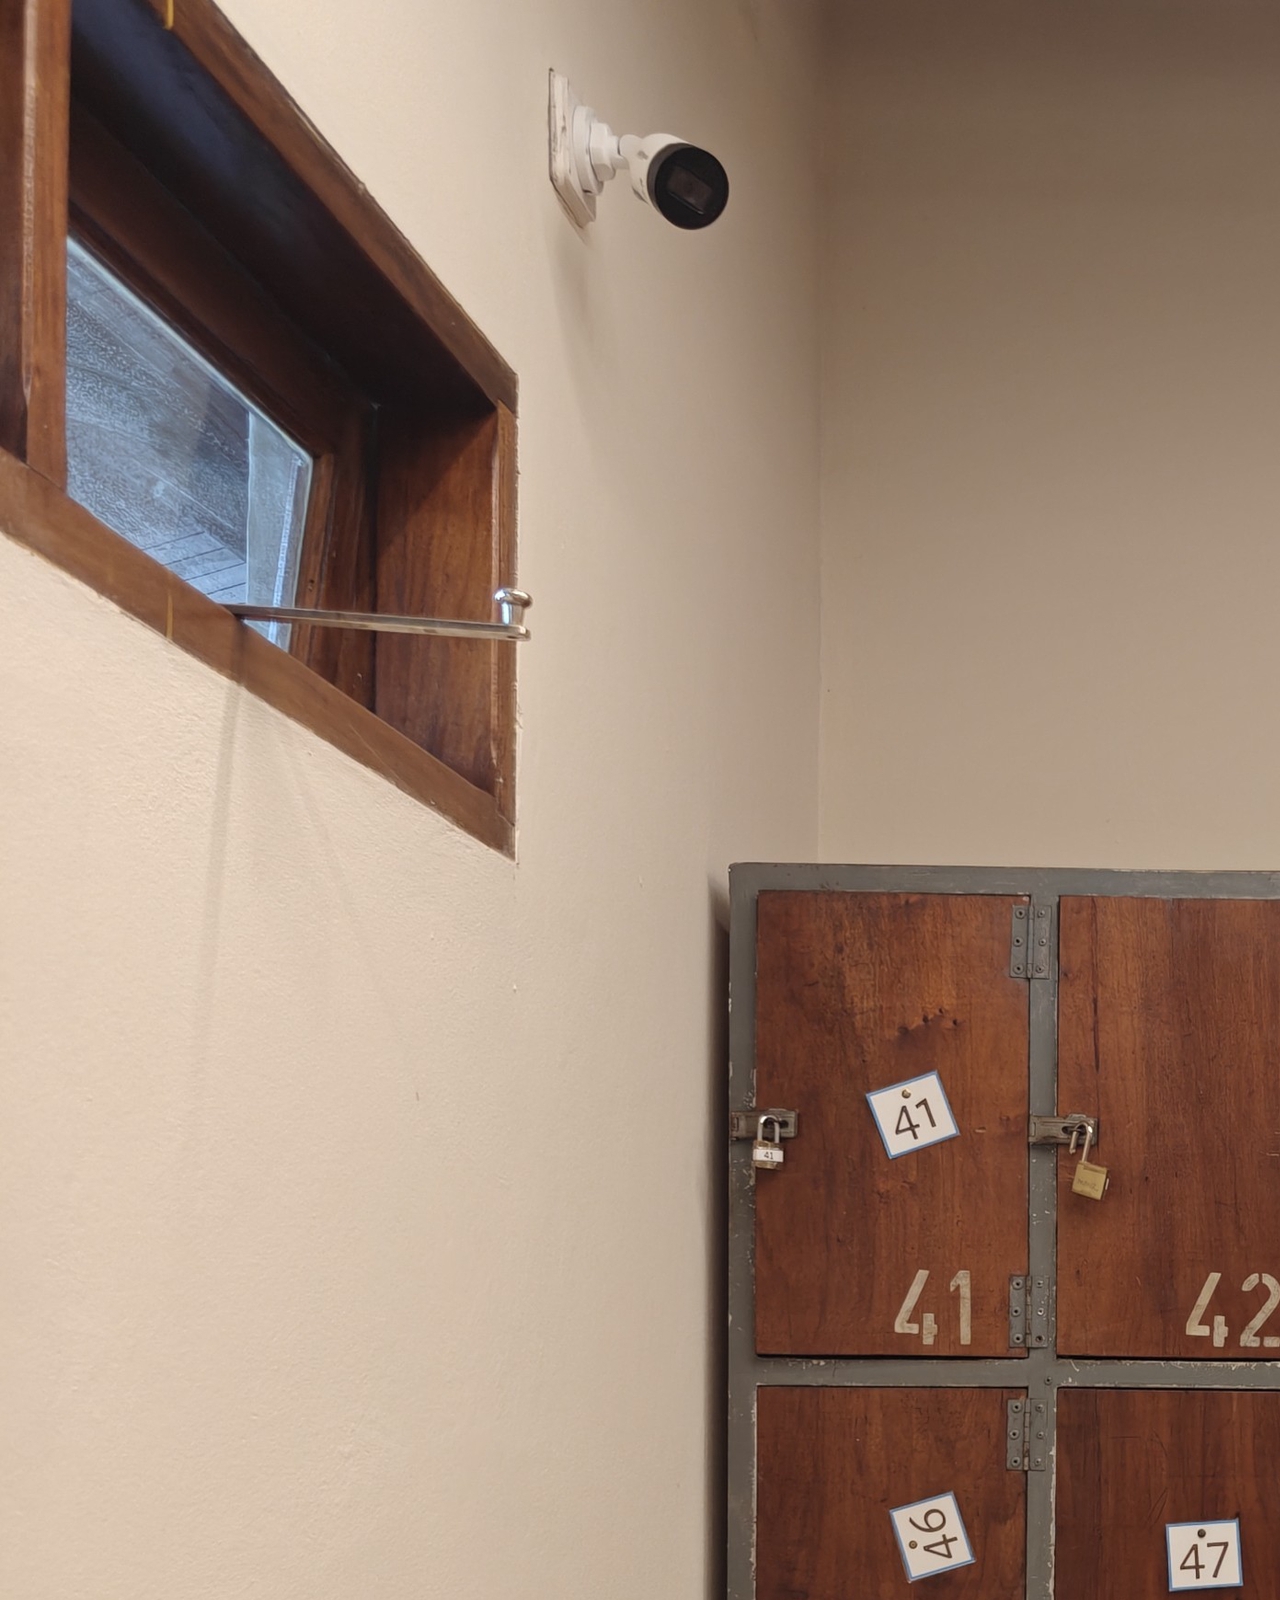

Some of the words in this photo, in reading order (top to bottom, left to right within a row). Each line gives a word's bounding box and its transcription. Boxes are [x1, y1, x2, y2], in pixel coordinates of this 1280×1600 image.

[895, 1098, 936, 1139] 41
[895, 1270, 971, 1345] 41
[1186, 1272, 1280, 1347] 42
[911, 1509, 958, 1558] 46
[1180, 1542, 1228, 1579] 47
